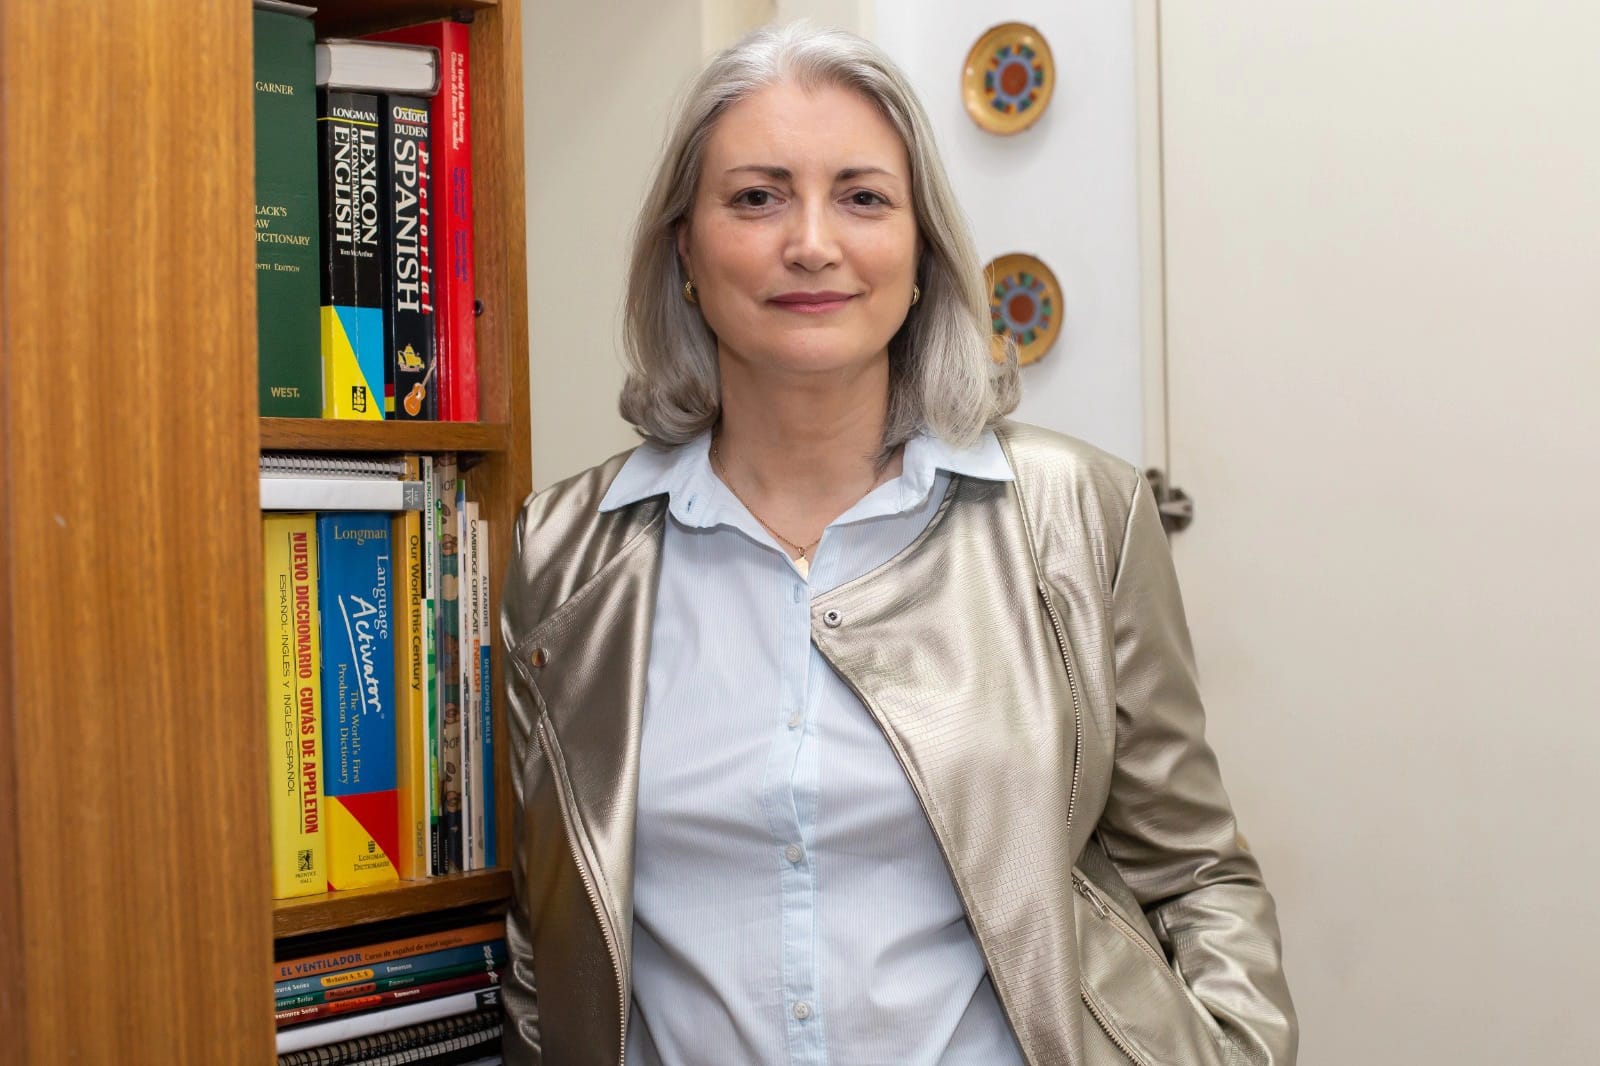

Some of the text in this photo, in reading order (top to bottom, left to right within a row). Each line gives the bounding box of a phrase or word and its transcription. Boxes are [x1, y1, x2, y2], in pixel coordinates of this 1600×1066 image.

[256, 81, 294, 95] GARNER
[333, 107, 376, 122] LONGMAN
[393, 106, 428, 123] Oxford
[394, 124, 428, 137] DUDEN
[255, 205, 288, 217] LACK'S
[255, 219, 270, 229] AW
[334, 126, 352, 243] ENGLISH
[351, 128, 361, 244] OF CONTEMPORARY
[360, 129, 378, 245] LEXICON
[394, 138, 419, 313] SPANISH
[419, 150, 433, 312] Pictorial
[334, 525, 387, 546] Longman
[373, 555, 389, 640] Language
[410, 535, 422, 691] Our World this Century
[293, 532, 319, 834] NUEVO DICCIONARIO CUYÁS DE APPLETON
[351, 594, 381, 713] Activator
[338, 664, 349, 784] Production Dictionary
[351, 690, 361, 783] The World's First
[281, 953, 362, 976] EL VENTILADOR
[416, 943, 423, 951] de
